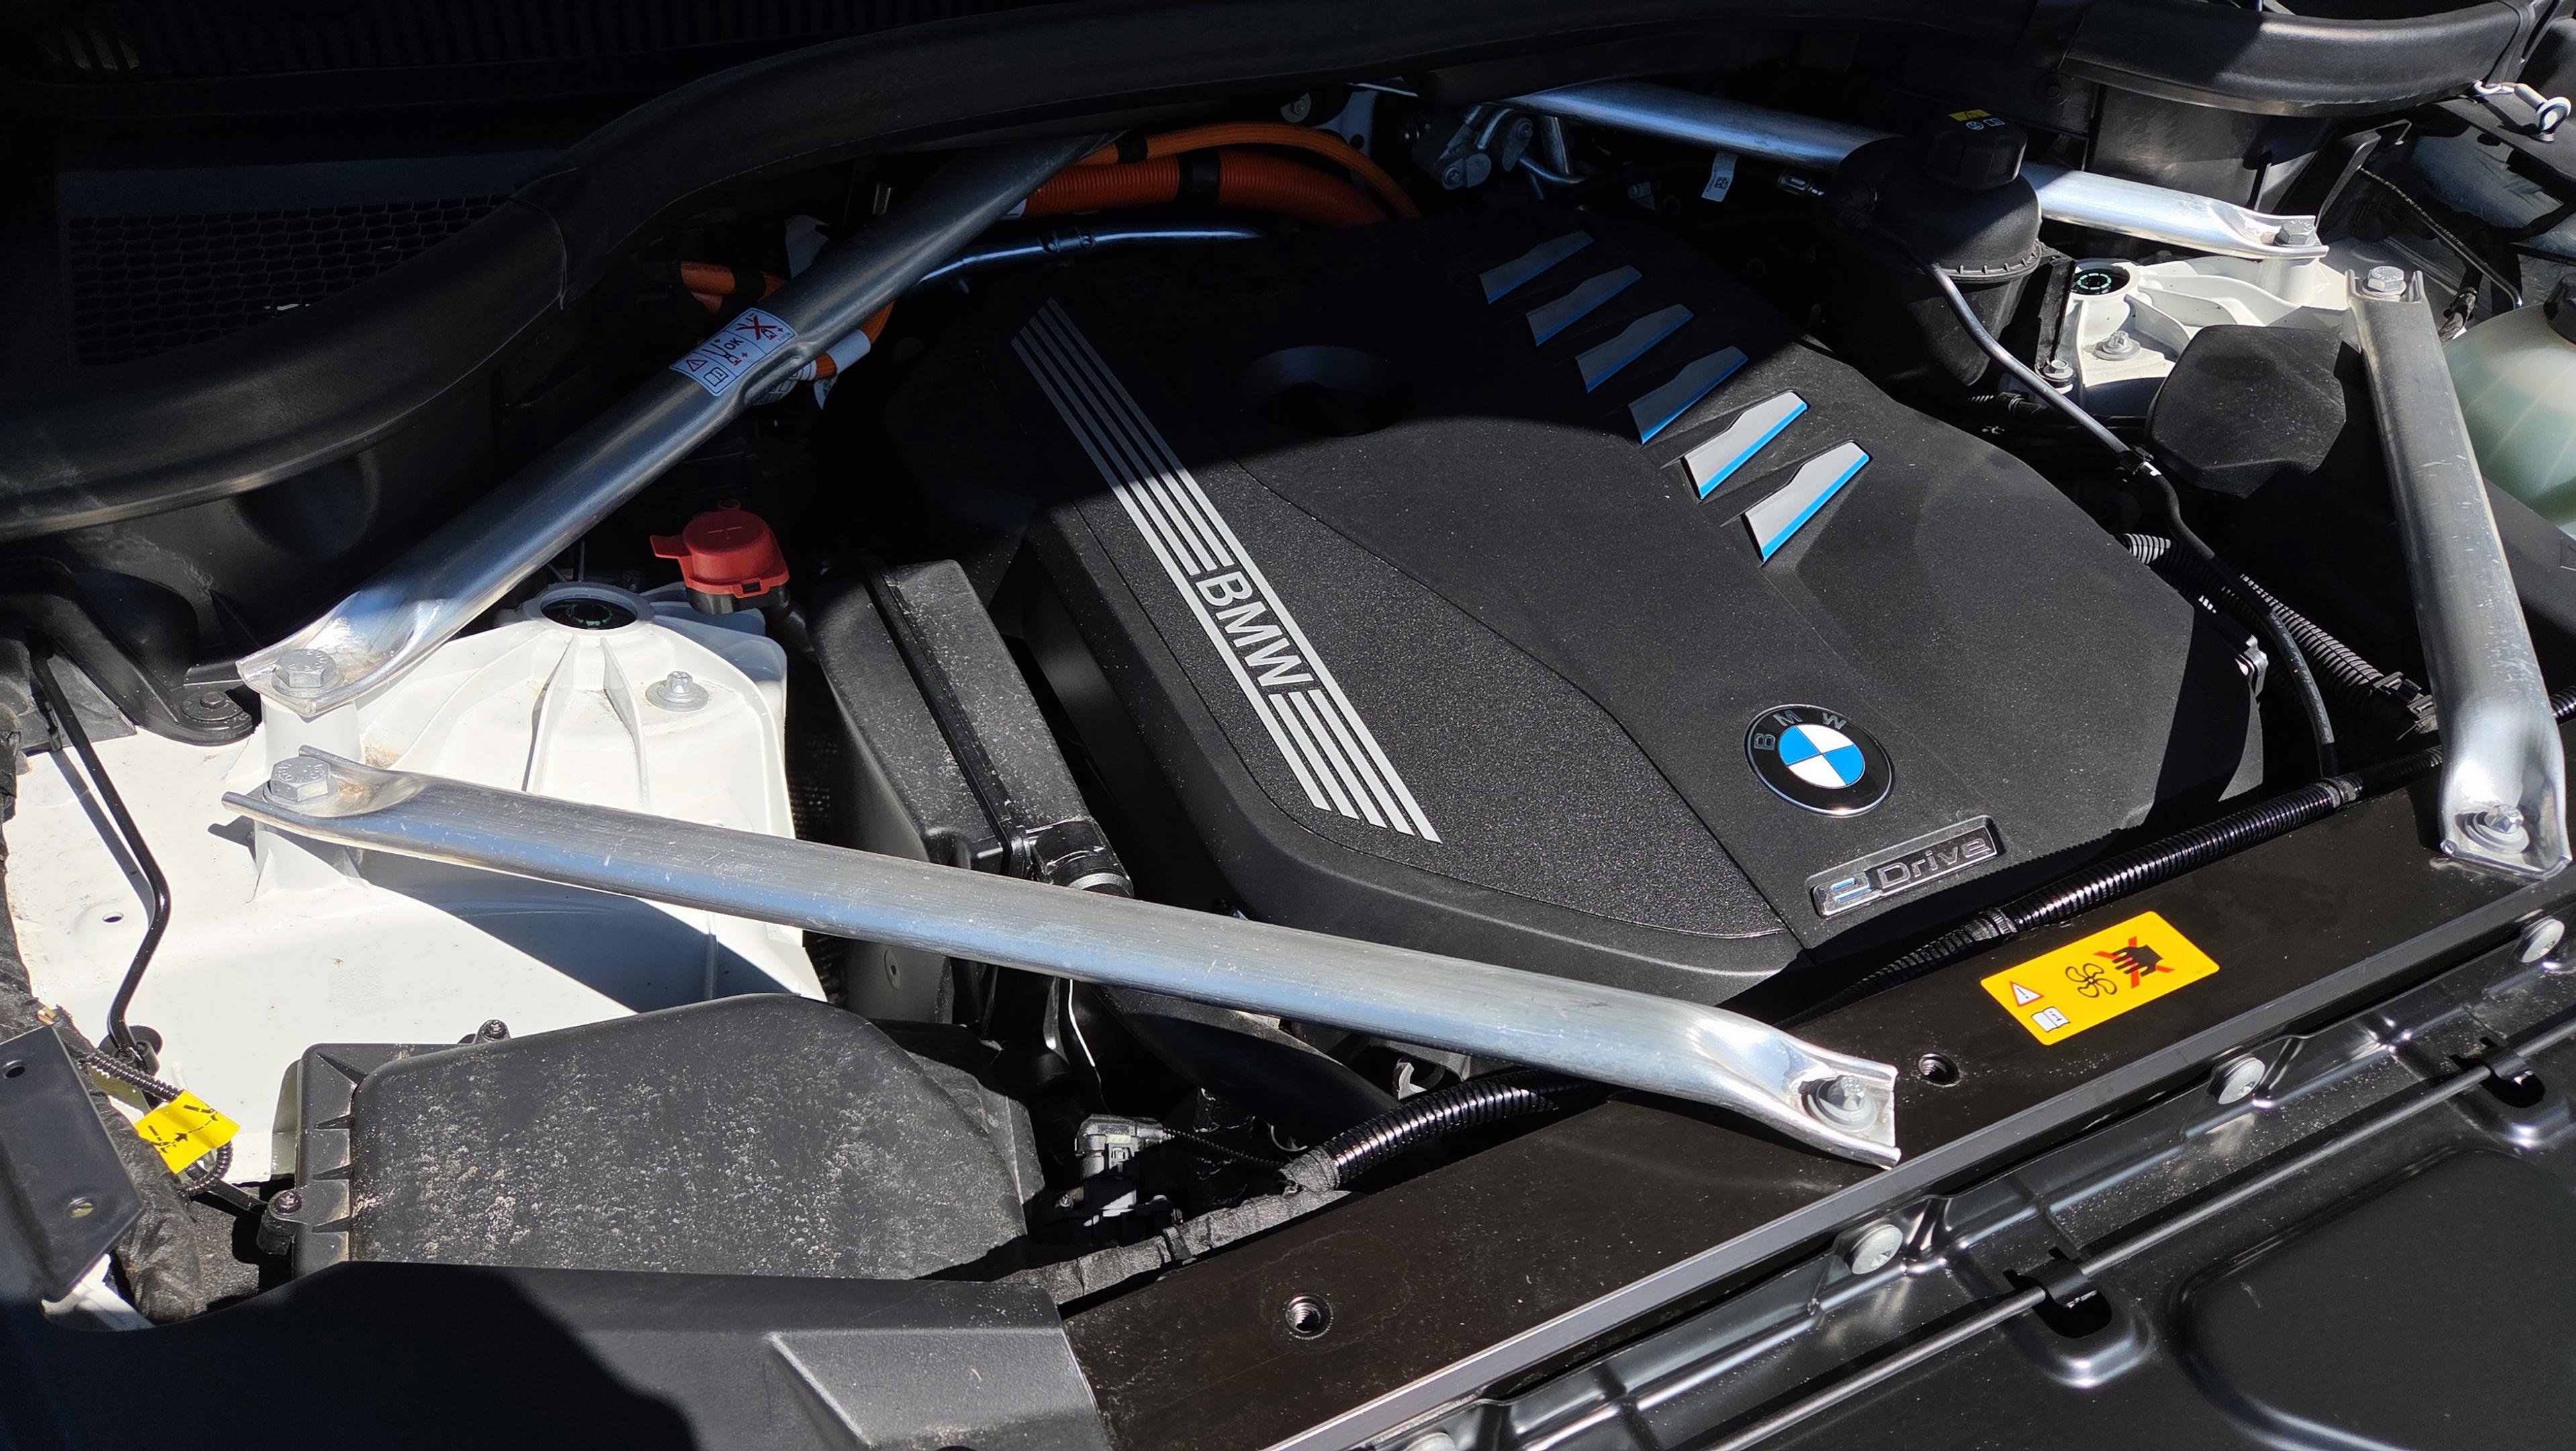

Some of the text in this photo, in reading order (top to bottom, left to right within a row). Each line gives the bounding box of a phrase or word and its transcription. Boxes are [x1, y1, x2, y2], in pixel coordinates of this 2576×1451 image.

[724, 337, 744, 351] OK
[1195, 571, 1314, 687] BMW
[1753, 709, 1847, 752] BMW
